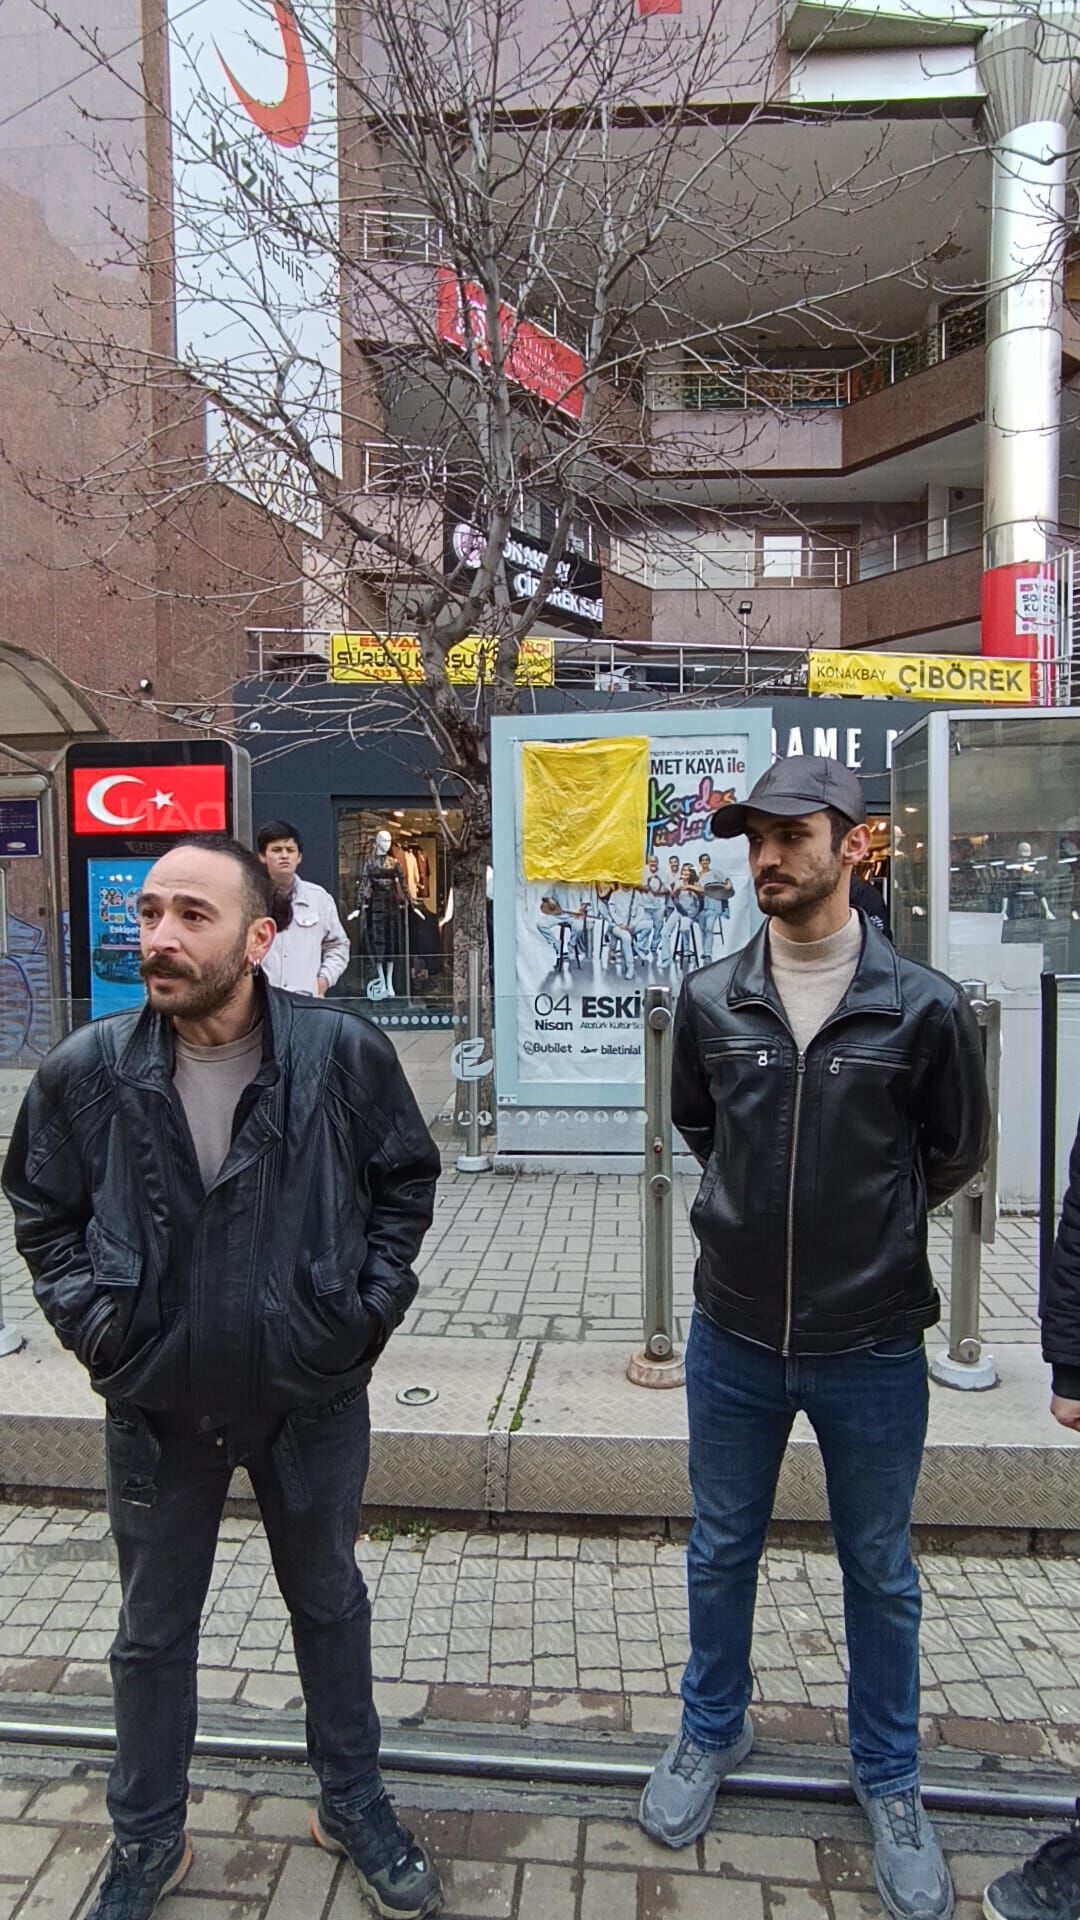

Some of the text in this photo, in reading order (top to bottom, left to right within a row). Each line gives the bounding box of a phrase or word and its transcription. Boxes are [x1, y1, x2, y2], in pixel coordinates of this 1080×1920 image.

[817, 660, 1024, 693] KONAKBAY ÇİBÖREK
[685, 758, 724, 775] KAYA
[727, 757, 745, 773] ile
[534, 990, 645, 1018] 04 ESKİ
[535, 1019, 573, 1031] Nisan
[534, 1043, 641, 1055] Bubilet biletinial
